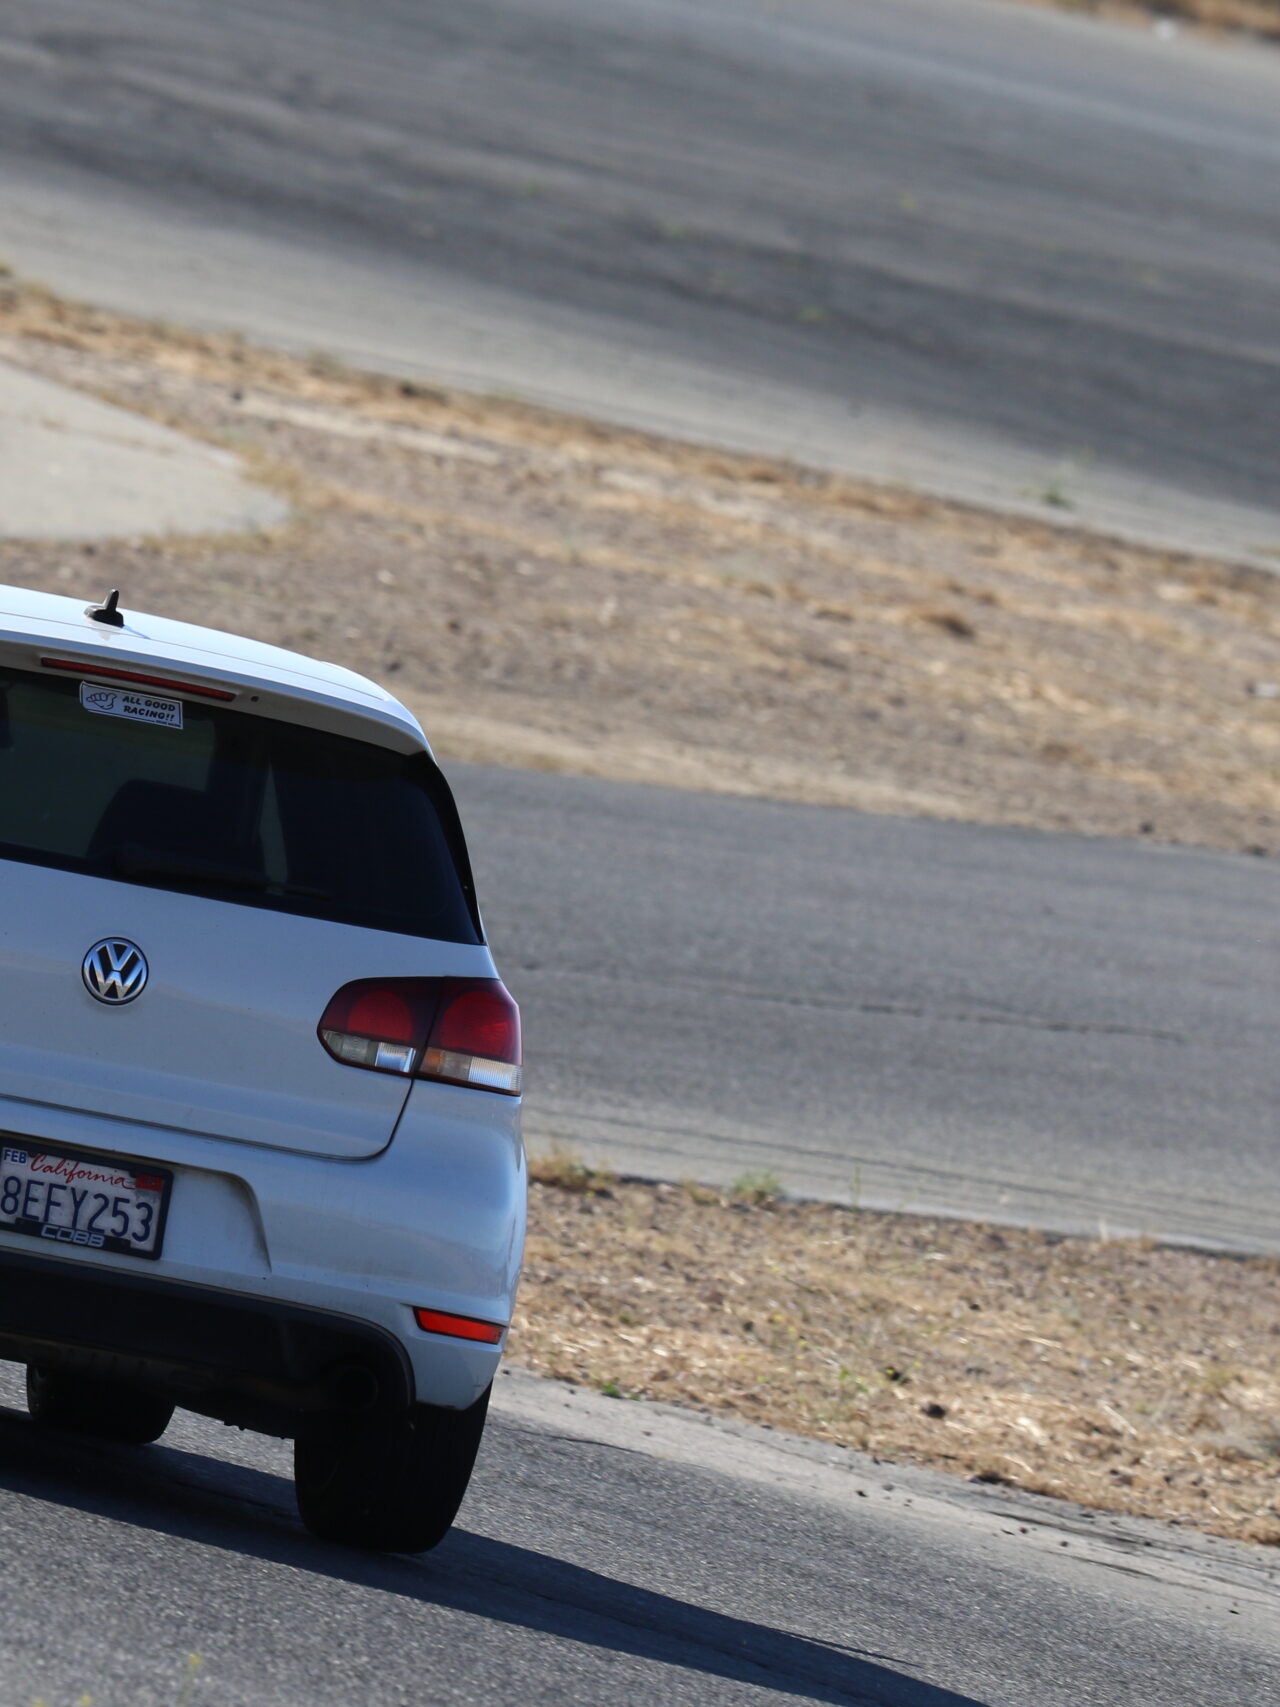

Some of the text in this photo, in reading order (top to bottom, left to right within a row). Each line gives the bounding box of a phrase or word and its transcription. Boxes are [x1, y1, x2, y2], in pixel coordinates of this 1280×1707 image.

[122, 695, 176, 713] ALL GOOD
[123, 705, 175, 722] RACING!!
[3, 1149, 28, 1165] FEB
[30, 1153, 136, 1191] California
[0, 1175, 154, 1243] 8EFY253
[41, 1224, 105, 1248] COBB
